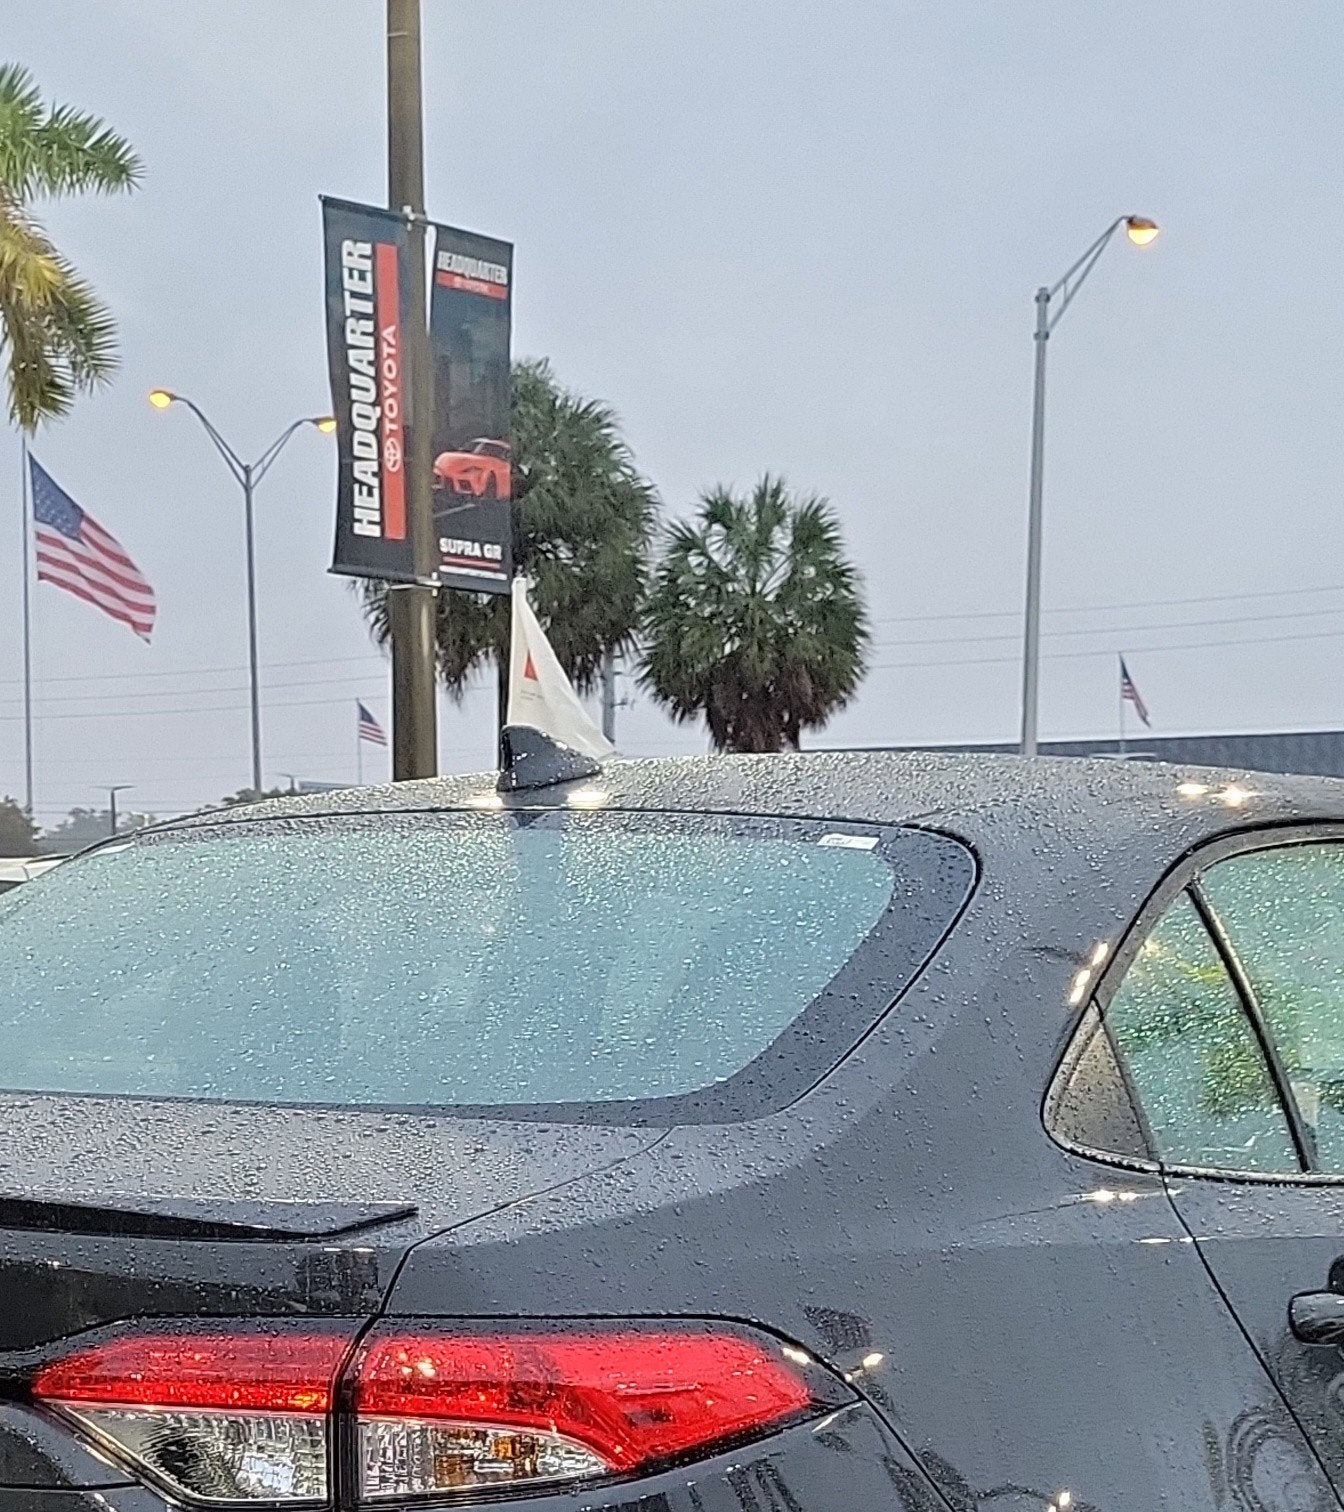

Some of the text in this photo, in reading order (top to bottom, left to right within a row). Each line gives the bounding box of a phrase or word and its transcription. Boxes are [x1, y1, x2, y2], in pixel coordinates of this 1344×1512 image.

[341, 240, 381, 538] HEADQUARTER
[381, 325, 400, 434] TOYOTA
[439, 537, 482, 557] SUPRA
